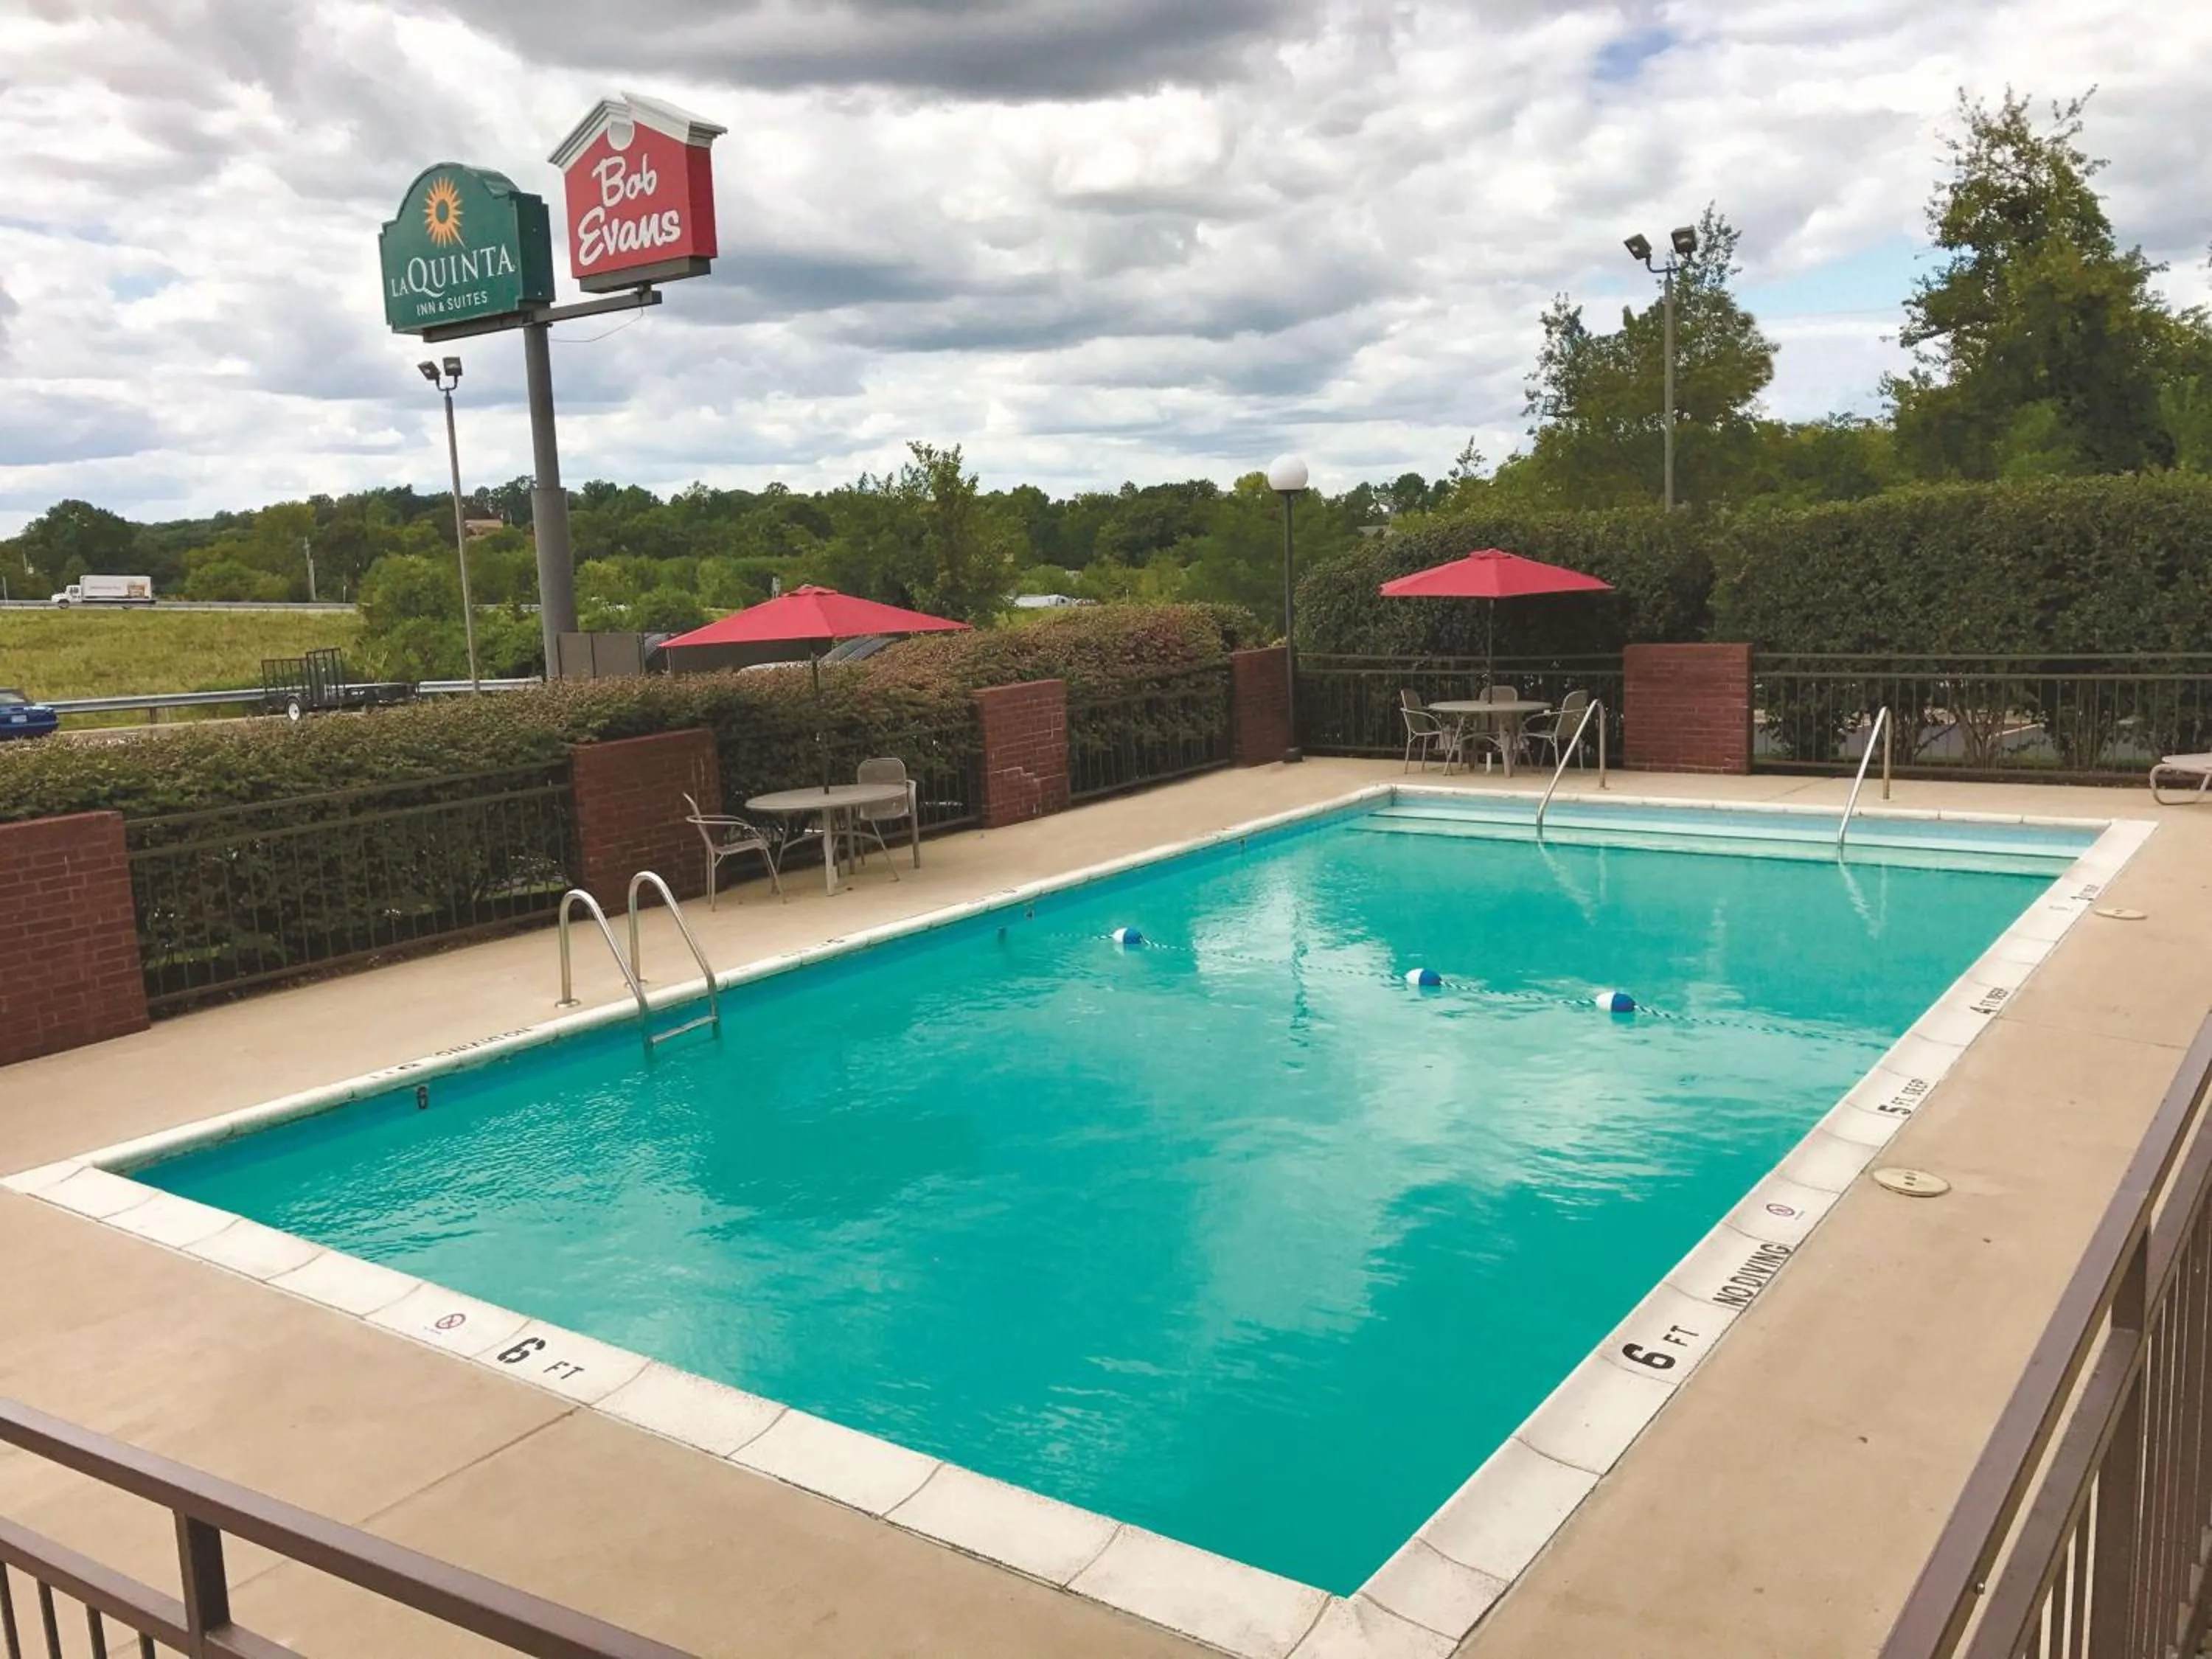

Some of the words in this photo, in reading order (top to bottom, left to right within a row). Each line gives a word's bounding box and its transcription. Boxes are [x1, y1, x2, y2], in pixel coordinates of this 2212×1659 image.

[591, 153, 657, 207] Bob
[577, 206, 681, 266] Evans
[417, 301, 436, 317] INN
[439, 304, 445, 312] &
[446, 291, 487, 310] SUITES
[1877, 1105, 1911, 1115] 5
[1730, 1244, 1792, 1287] DIVING
[1712, 1285, 1754, 1307] NO
[497, 1337, 546, 1364] 6
[543, 1360, 585, 1380] FT
[1622, 1343, 1676, 1370] 6
[1663, 1325, 1699, 1347] FT
